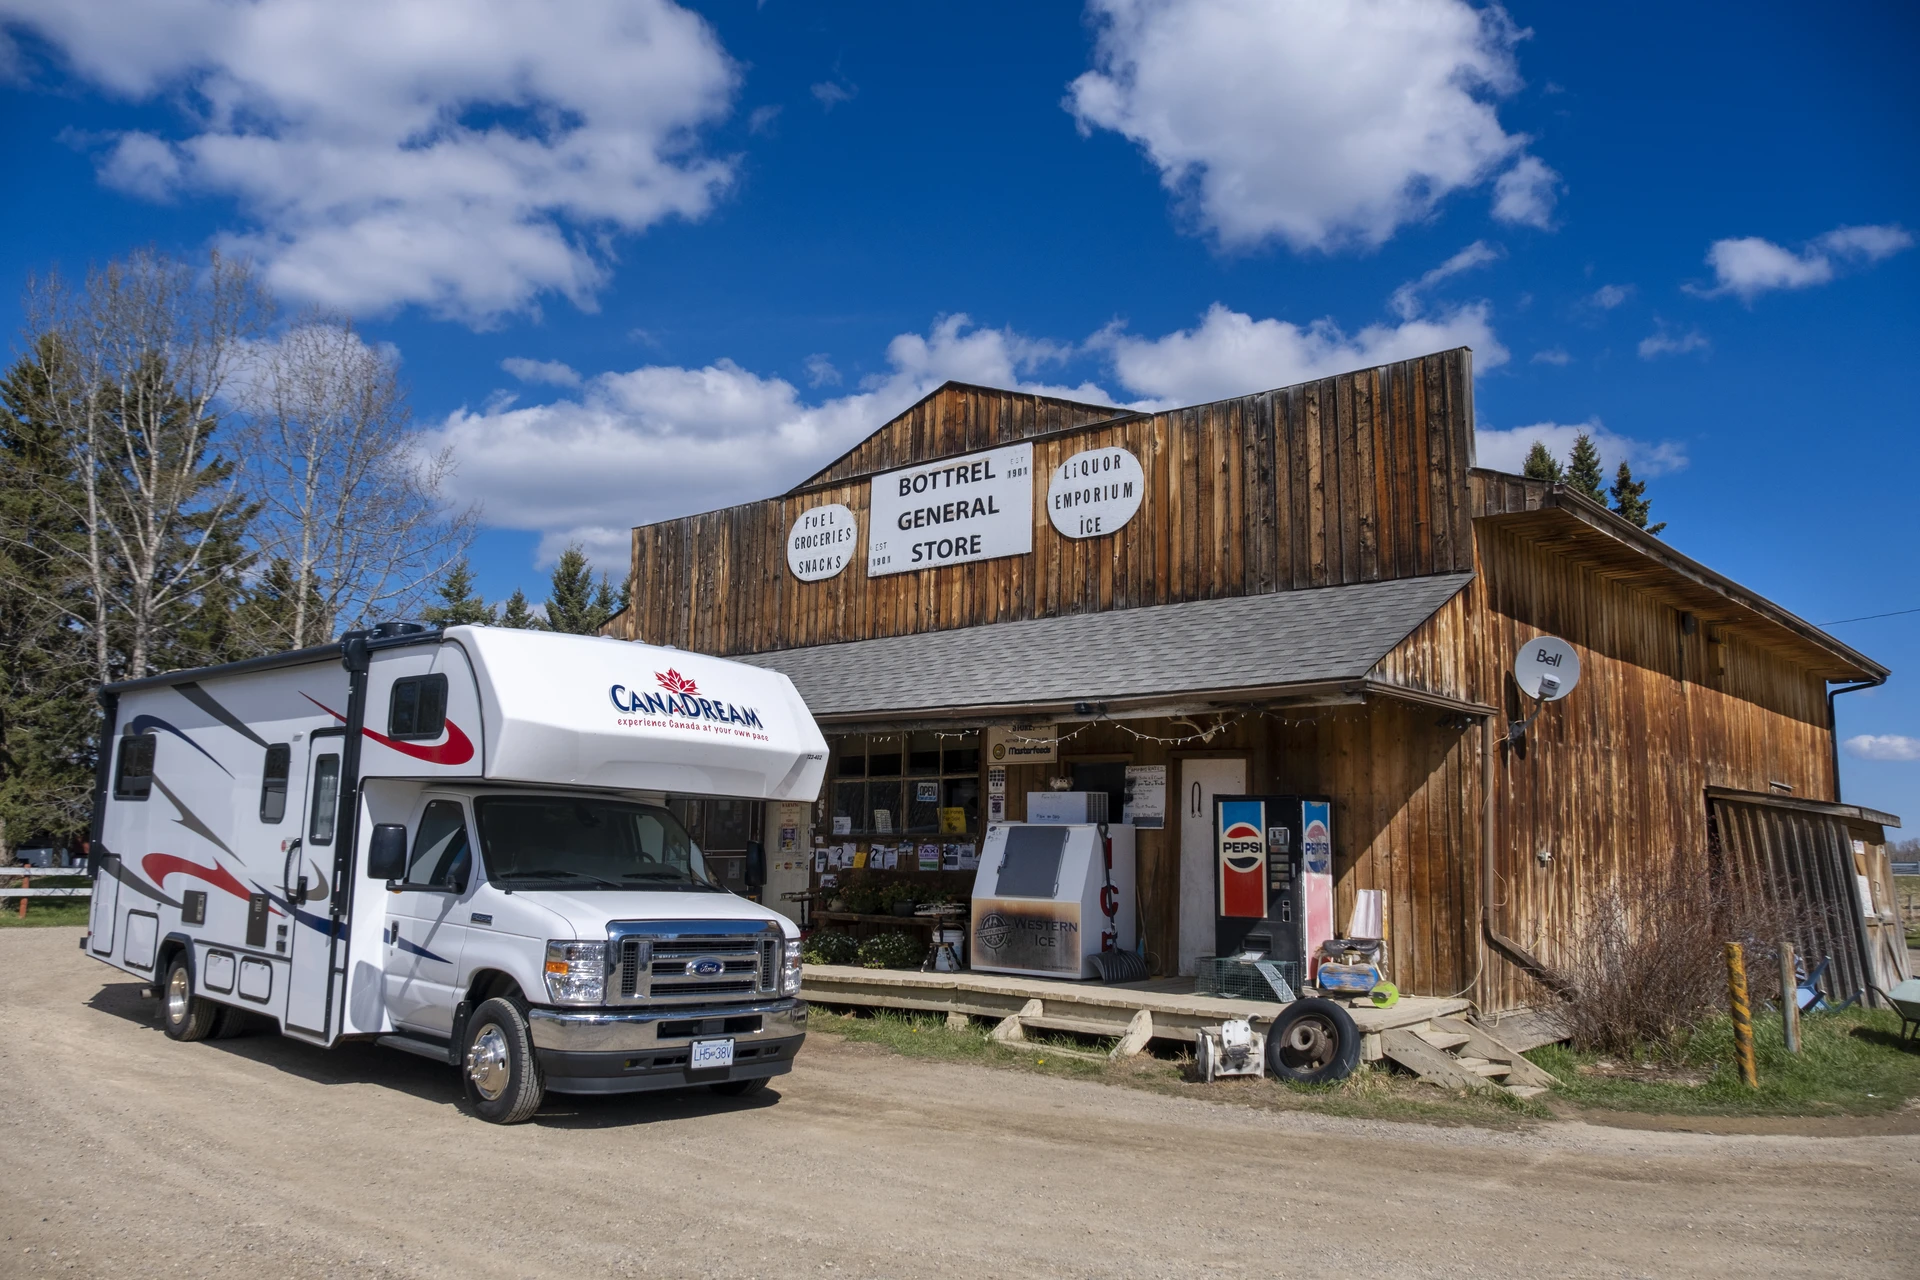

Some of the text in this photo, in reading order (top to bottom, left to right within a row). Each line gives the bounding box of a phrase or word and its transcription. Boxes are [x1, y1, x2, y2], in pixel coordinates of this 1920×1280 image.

[899, 460, 996, 497] BOTTREL
[1006, 466, 1028, 479] 1901
[1055, 481, 1133, 510] EMPORIUM
[897, 495, 1000, 531] GENERAL
[794, 527, 852, 550] GROCERIES
[875, 541, 888, 552] EST
[911, 534, 982, 563] STORE
[798, 555, 842, 574] SNACKS
[872, 555, 891, 567] 1901
[1536, 648, 1562, 667] Bell
[617, 718, 769, 742] experience Canada at your own pace
[1009, 746, 1051, 755] Masterfeeds
[919, 785, 936, 796] OPEN
[1223, 841, 1262, 853] PEPSI
[1305, 842, 1330, 855] PEPSI
[1014, 917, 1078, 933] WESTERN
[1035, 934, 1056, 947] ICE
[700, 963, 717, 972] Ford
[694, 1046, 732, 1061] LH5 38V
